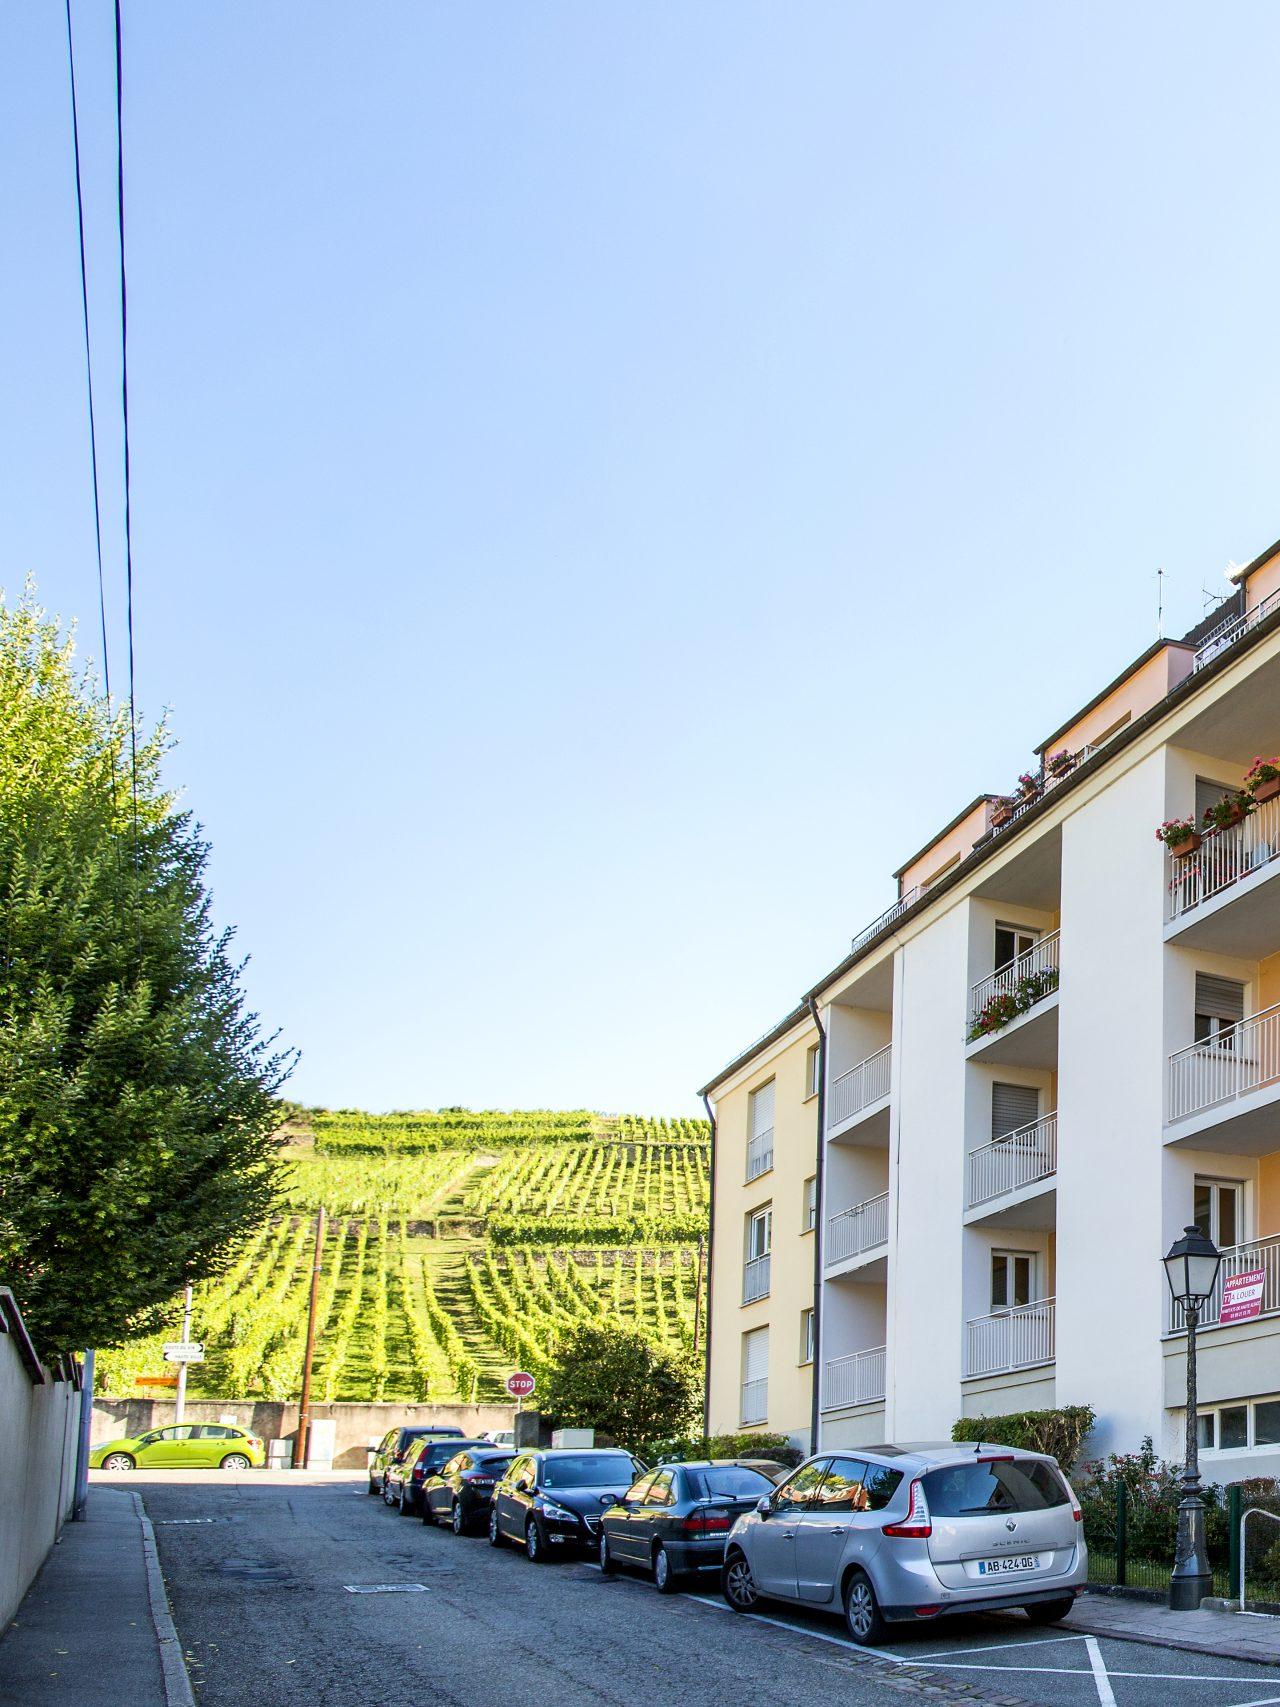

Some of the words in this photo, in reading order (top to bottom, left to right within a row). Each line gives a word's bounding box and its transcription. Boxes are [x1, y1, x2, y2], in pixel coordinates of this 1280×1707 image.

[1225, 1272, 1264, 1289] APPARTEMENT
[1236, 1288, 1256, 1300] LOUER
[510, 1380, 533, 1388] STOP
[987, 1557, 1033, 1573] AB-424-QG
